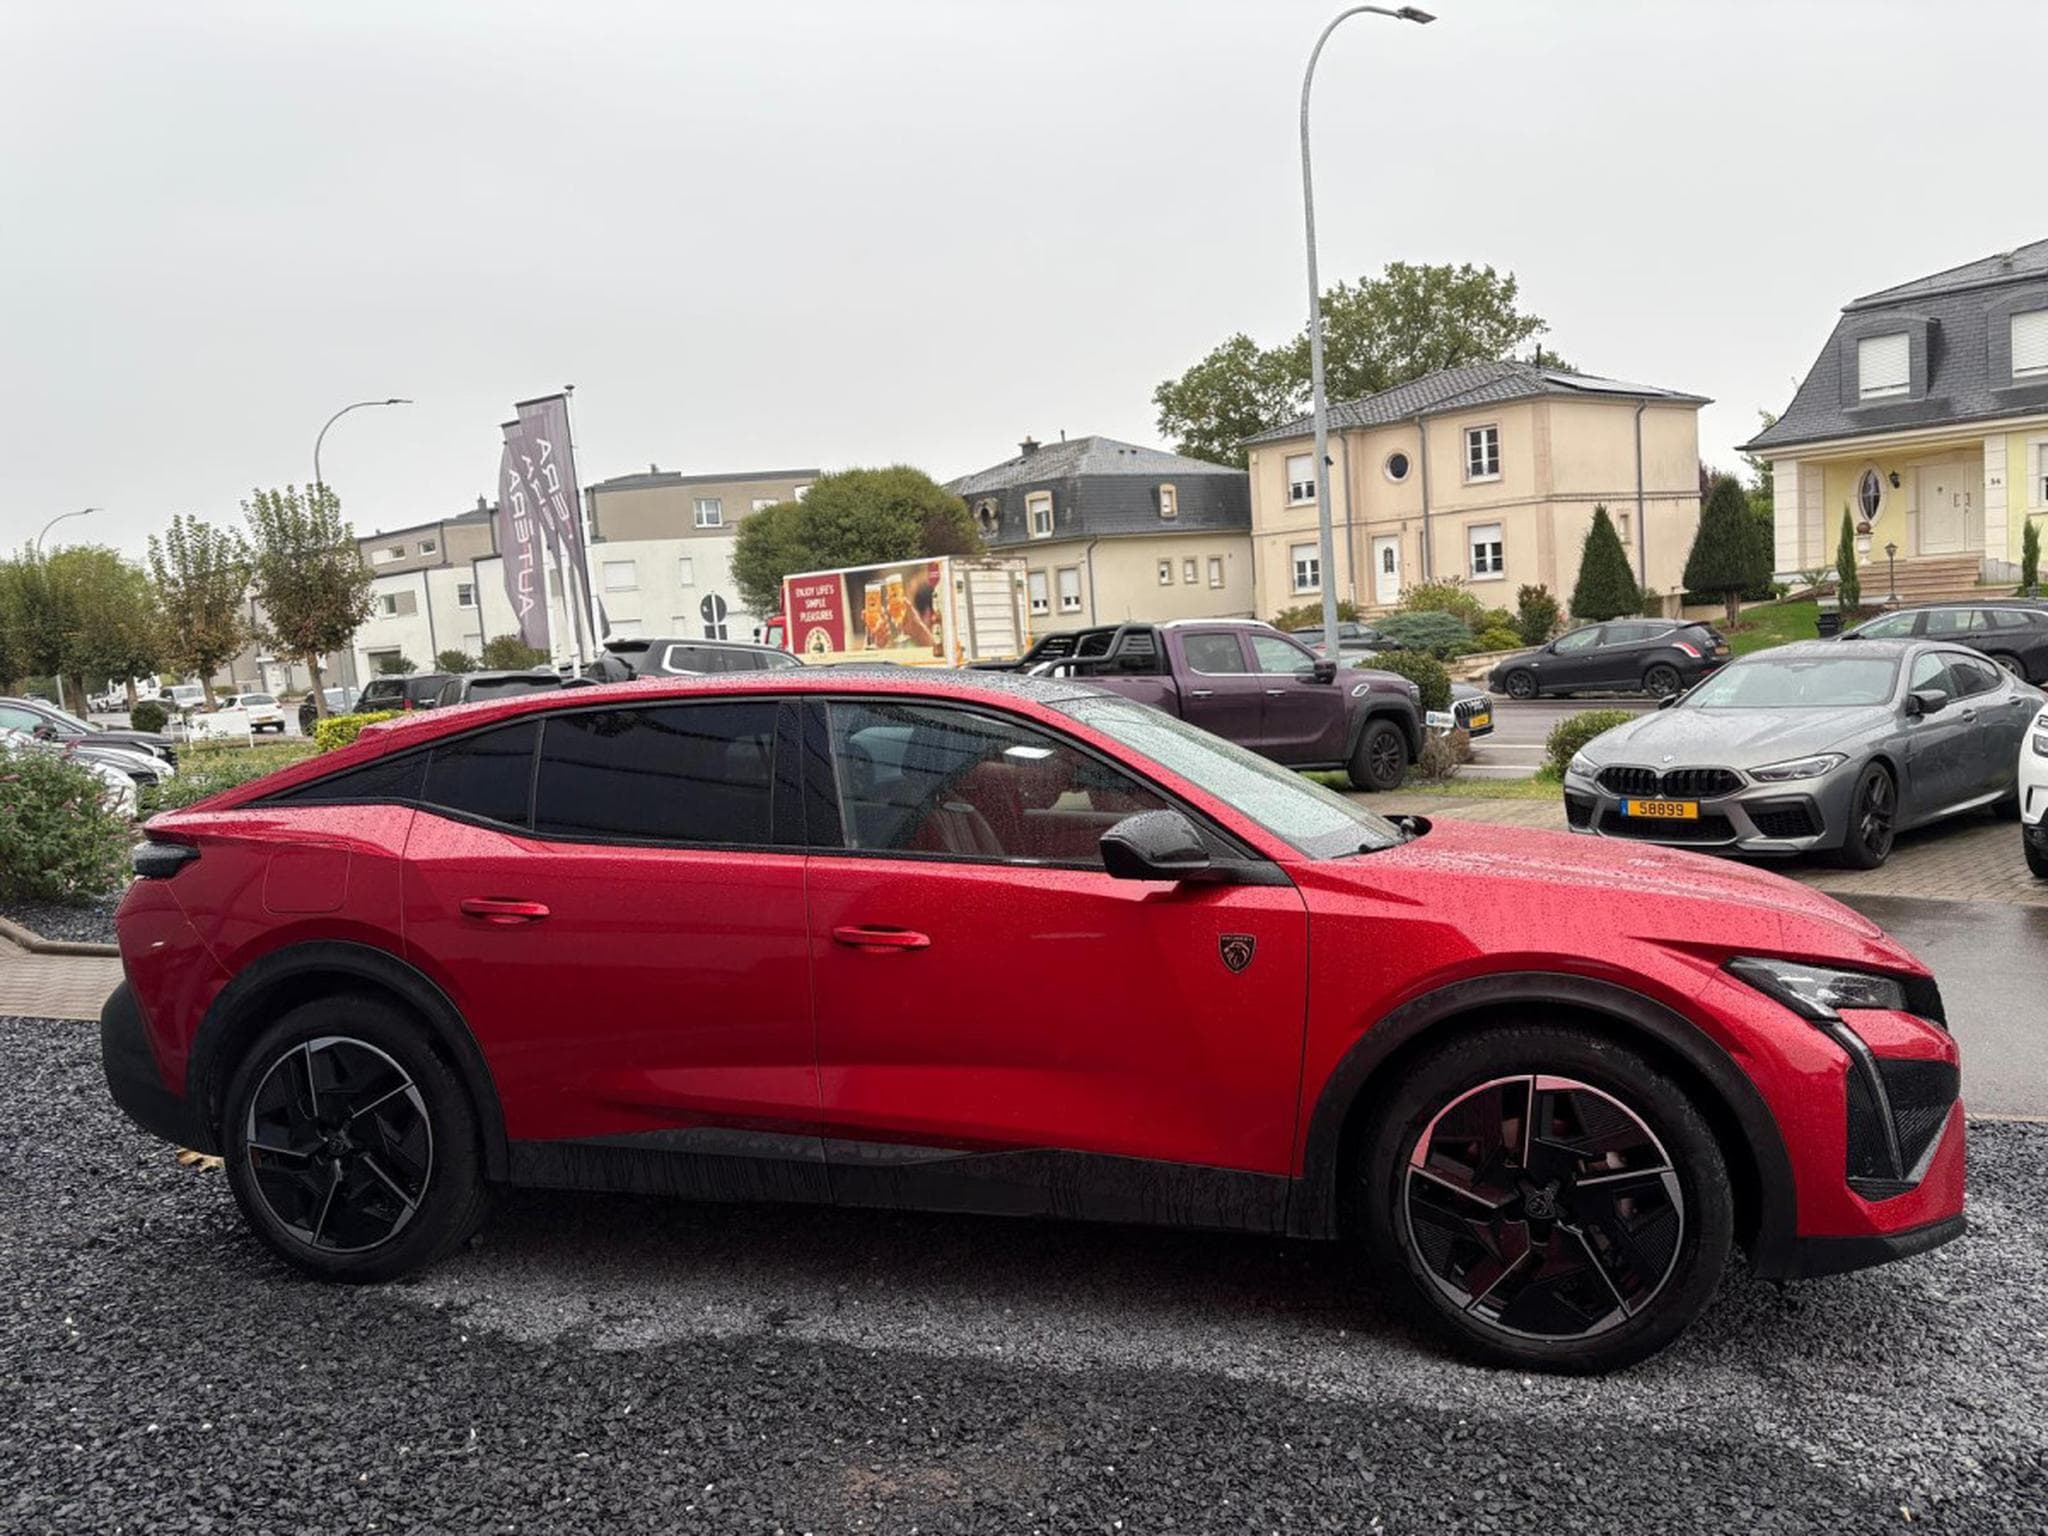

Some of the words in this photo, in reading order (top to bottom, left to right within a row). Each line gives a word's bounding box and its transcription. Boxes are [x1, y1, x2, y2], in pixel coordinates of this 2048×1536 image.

[795, 586, 815, 598] ENJOY
[804, 597, 826, 609] SIMPLE
[799, 609, 834, 622] PLEASURES
[1640, 801, 1684, 816] 58899
